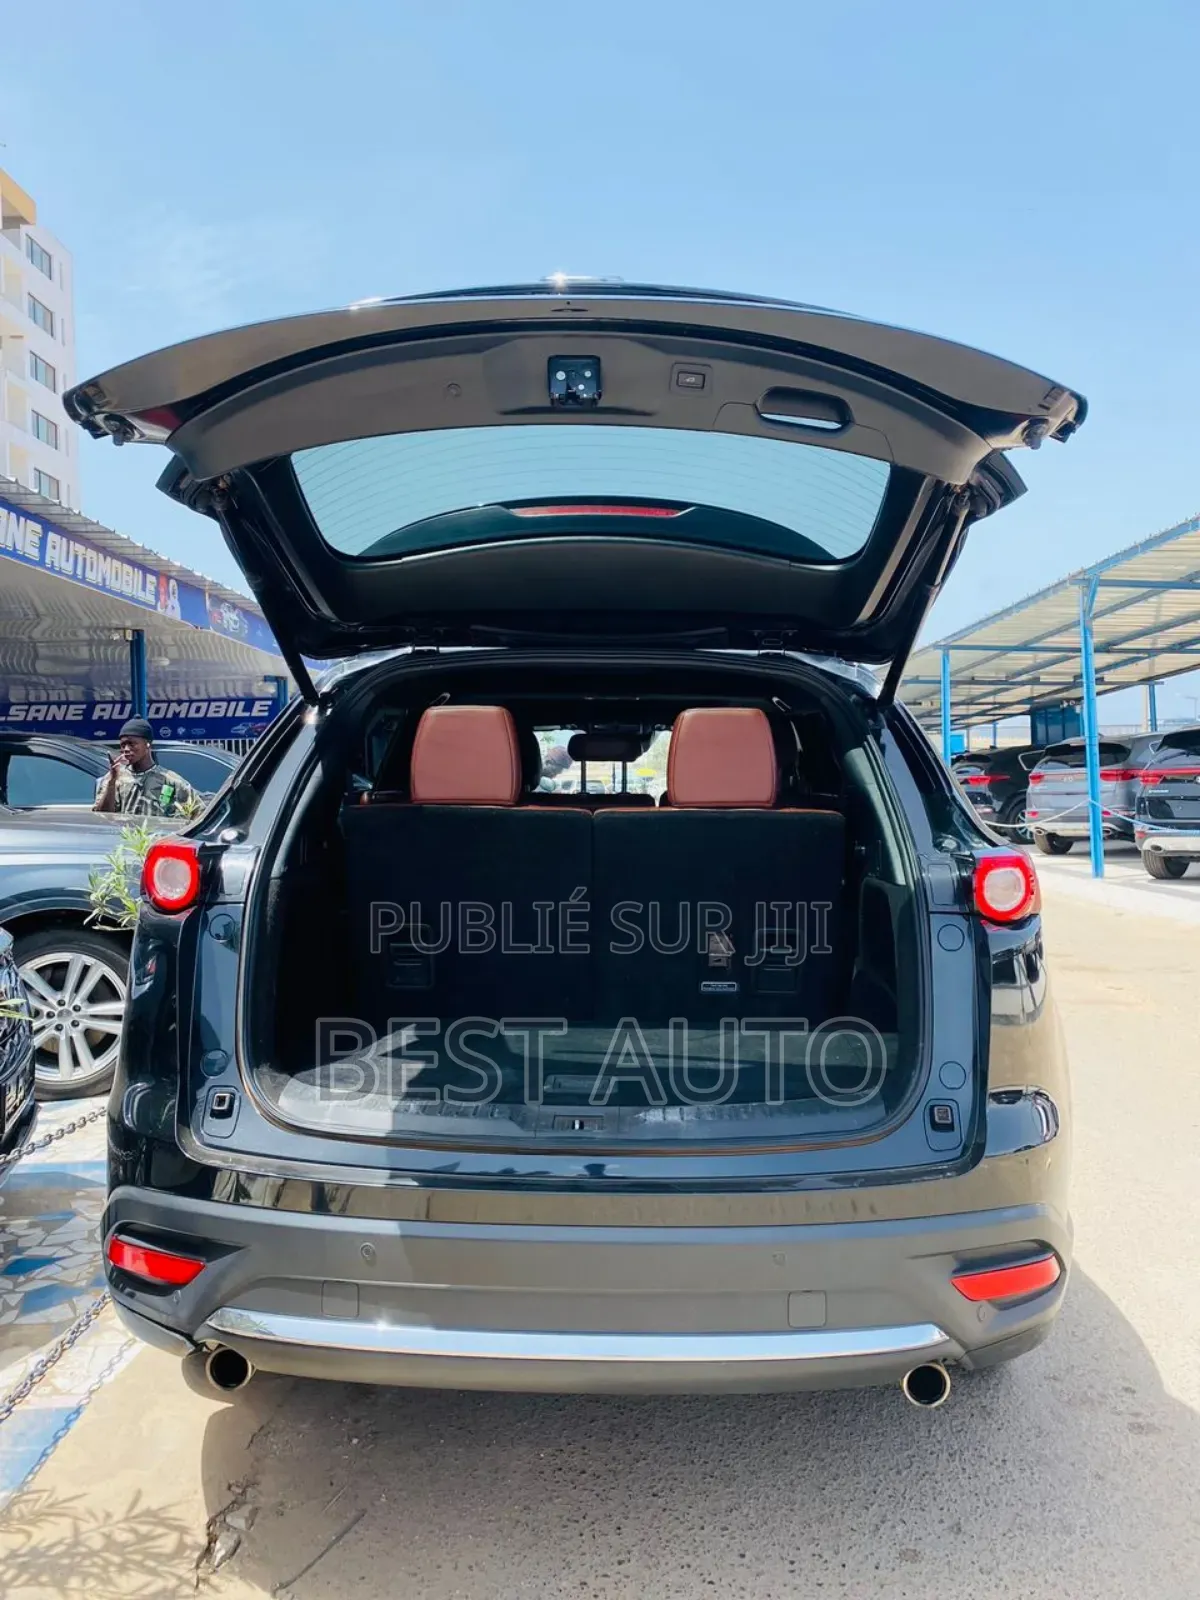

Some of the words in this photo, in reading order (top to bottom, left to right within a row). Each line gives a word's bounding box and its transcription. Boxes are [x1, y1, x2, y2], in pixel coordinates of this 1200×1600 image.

[45, 531, 157, 606] AUTOMOBILE
[0, 704, 87, 721] SANE
[92, 700, 273, 720] AUOMOBILE
